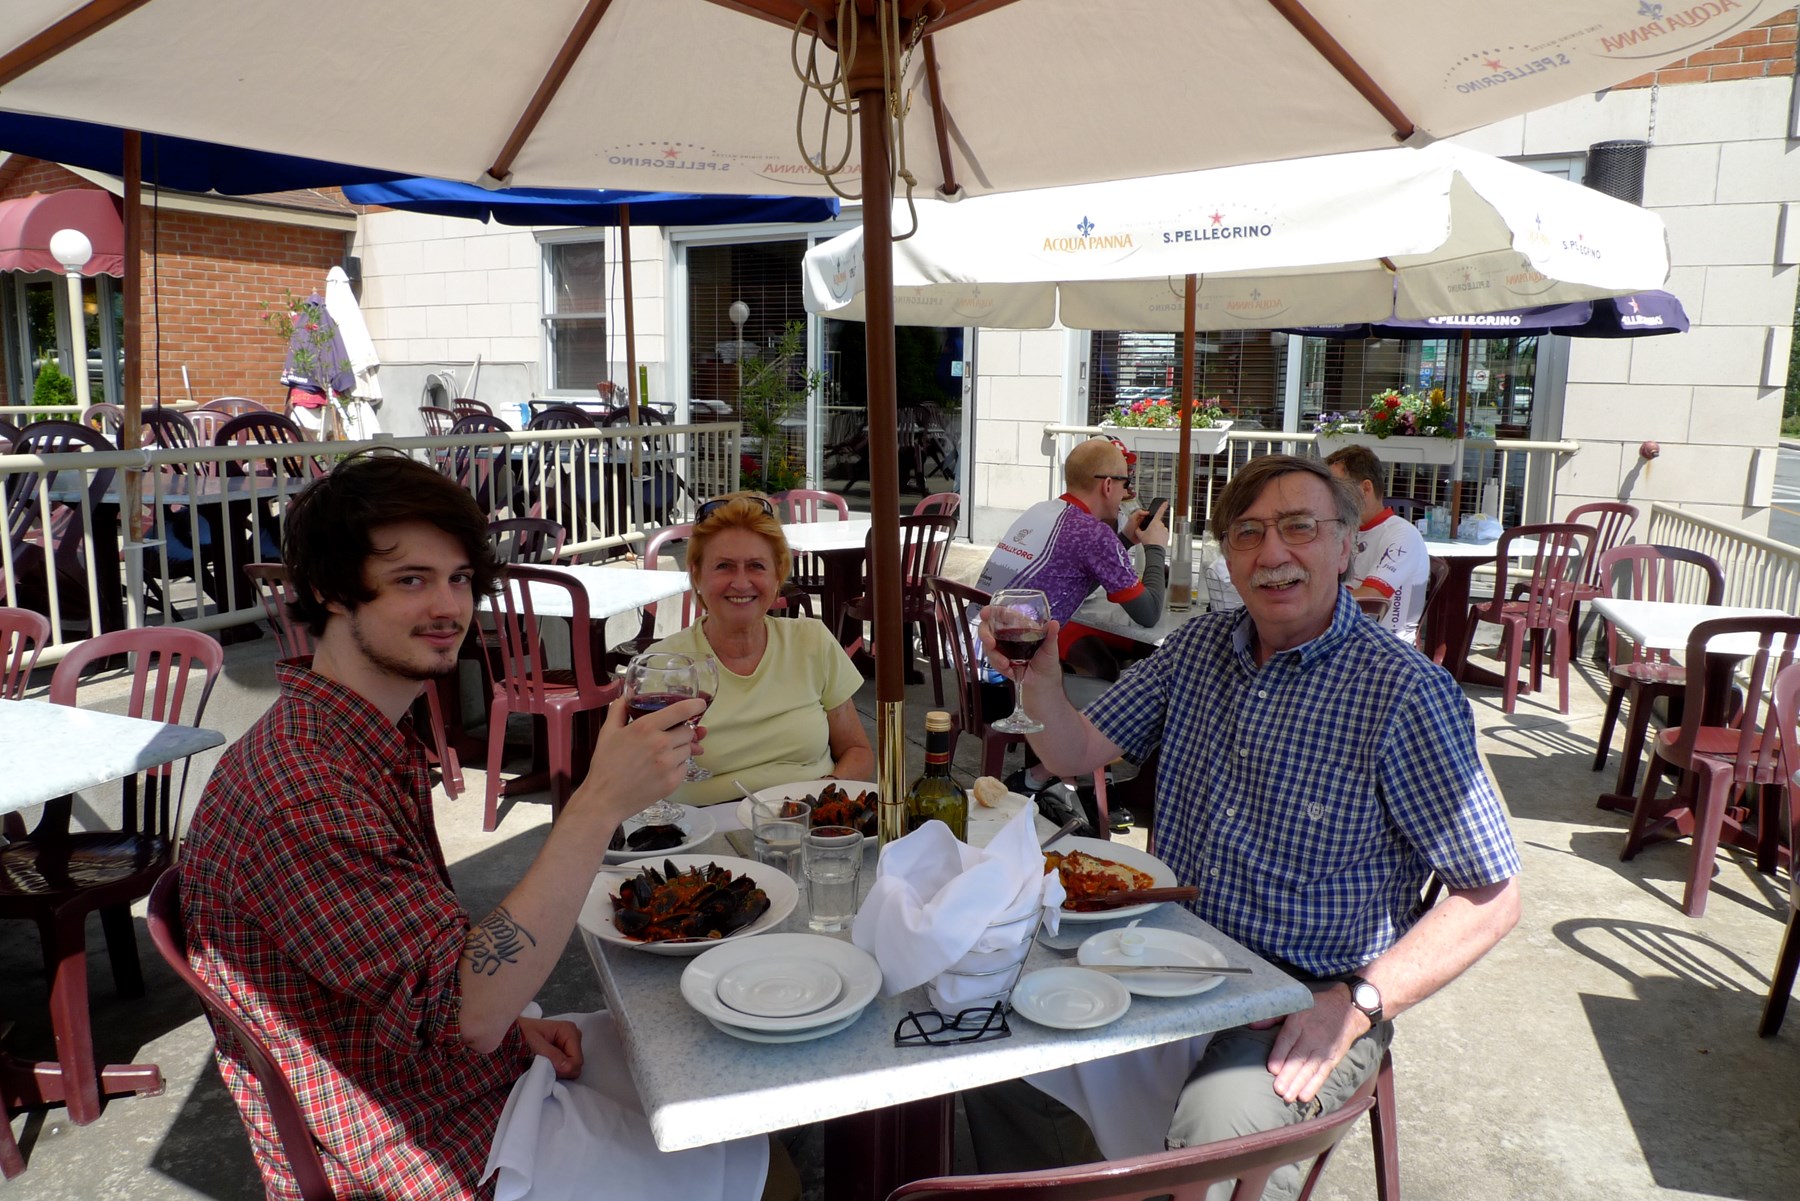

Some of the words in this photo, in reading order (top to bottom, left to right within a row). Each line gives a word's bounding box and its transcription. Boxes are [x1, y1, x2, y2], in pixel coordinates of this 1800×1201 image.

[1043, 237, 1087, 253] ACQUA
[1089, 233, 1133, 249] PANNA
[1163, 225, 1272, 243] S.PELLEGRINO
